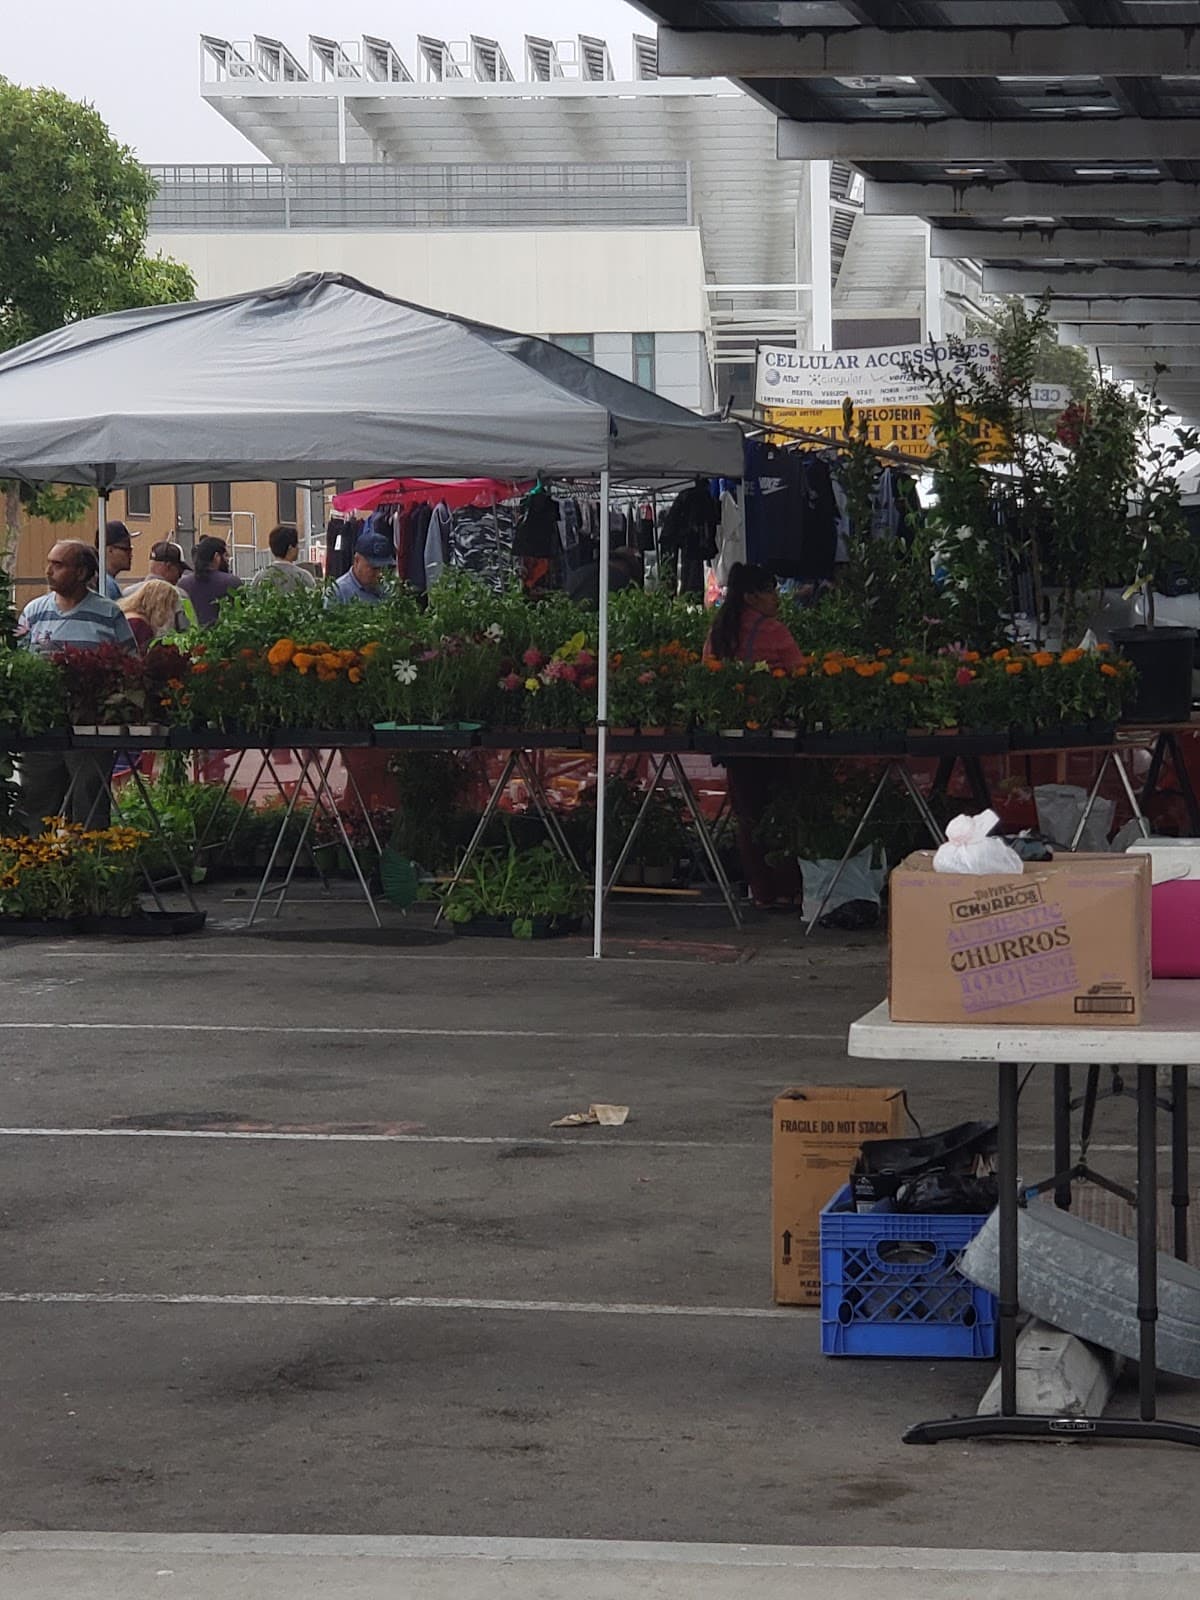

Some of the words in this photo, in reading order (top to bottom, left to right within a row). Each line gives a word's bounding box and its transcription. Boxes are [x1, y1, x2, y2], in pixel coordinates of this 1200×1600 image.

[765, 352, 860, 370] CELLULAR
[864, 343, 990, 369] ACCESSORES
[782, 375, 800, 383] AT&T
[822, 373, 862, 385] cingular
[858, 408, 921, 421] RELOJERIA
[955, 889, 1039, 919] CHURROS
[948, 902, 1064, 943] AUTHENTIC
[950, 925, 1072, 973] CHURROS
[780, 1119, 819, 1134] FRAGILE
[821, 1120, 835, 1134] DO
[837, 1121, 857, 1134] NOT
[858, 1121, 889, 1134] STACK
